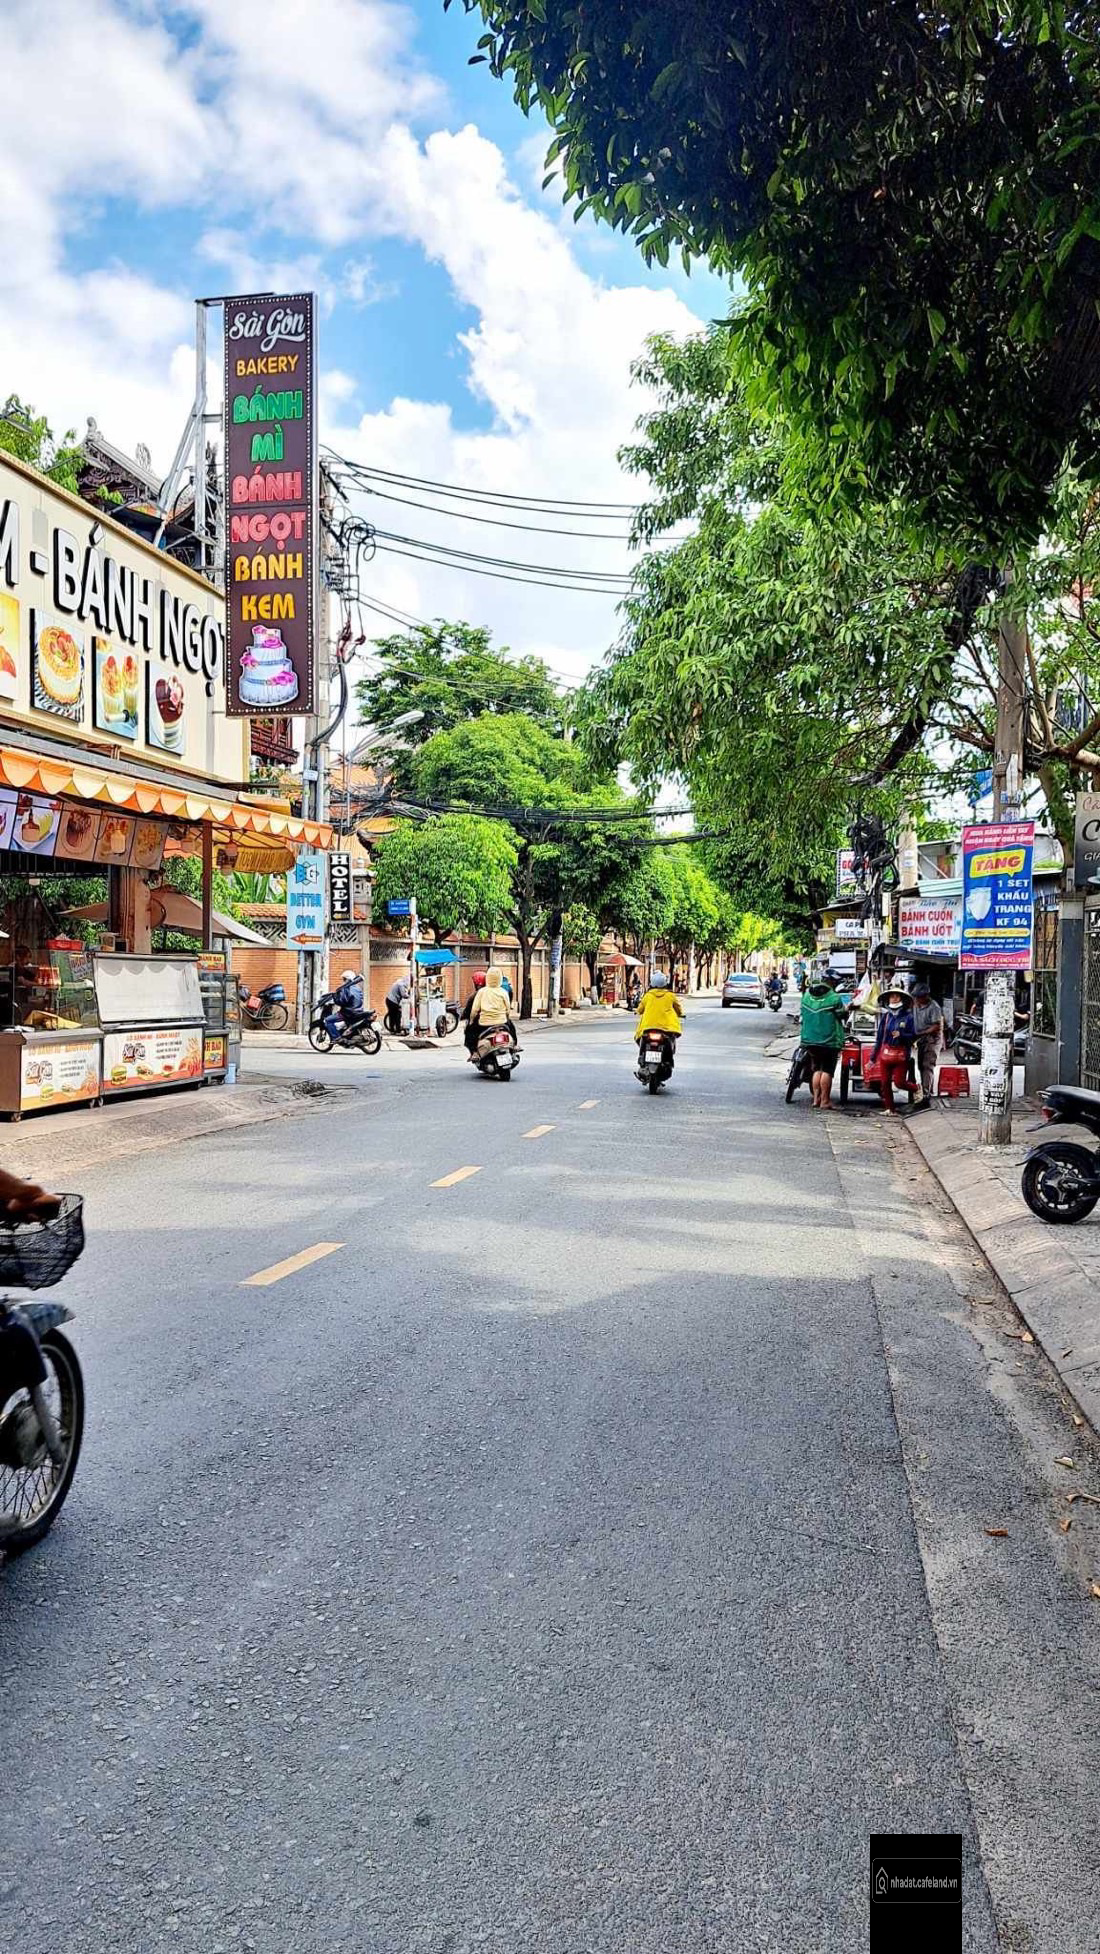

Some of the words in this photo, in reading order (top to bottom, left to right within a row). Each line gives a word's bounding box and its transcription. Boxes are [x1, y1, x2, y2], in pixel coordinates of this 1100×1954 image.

[229, 310, 263, 340] Sài
[261, 308, 306, 352] Gòn
[236, 354, 299, 376] BAKERY
[233, 385, 303, 424] BÁNH
[251, 424, 284, 463] MÌ
[232, 465, 302, 503] BÁNH
[231, 511, 306, 550] NGỌT
[235, 546, 303, 582] BÁNH
[54, 521, 153, 653] BÁNH
[160, 589, 225, 697] NGỌ
[241, 592, 296, 622] KEM
[331, 854, 349, 912] HOTEL
[998, 880, 1003, 888] 1
[1007, 879, 1030, 888] SET
[295, 914, 316, 930] GYM
[901, 908, 926, 922] BÁNH
[994, 904, 1031, 914] TRANG
[996, 917, 1010, 926] KF
[1013, 917, 1028, 926] 94
[901, 923, 929, 937] BÁNH
